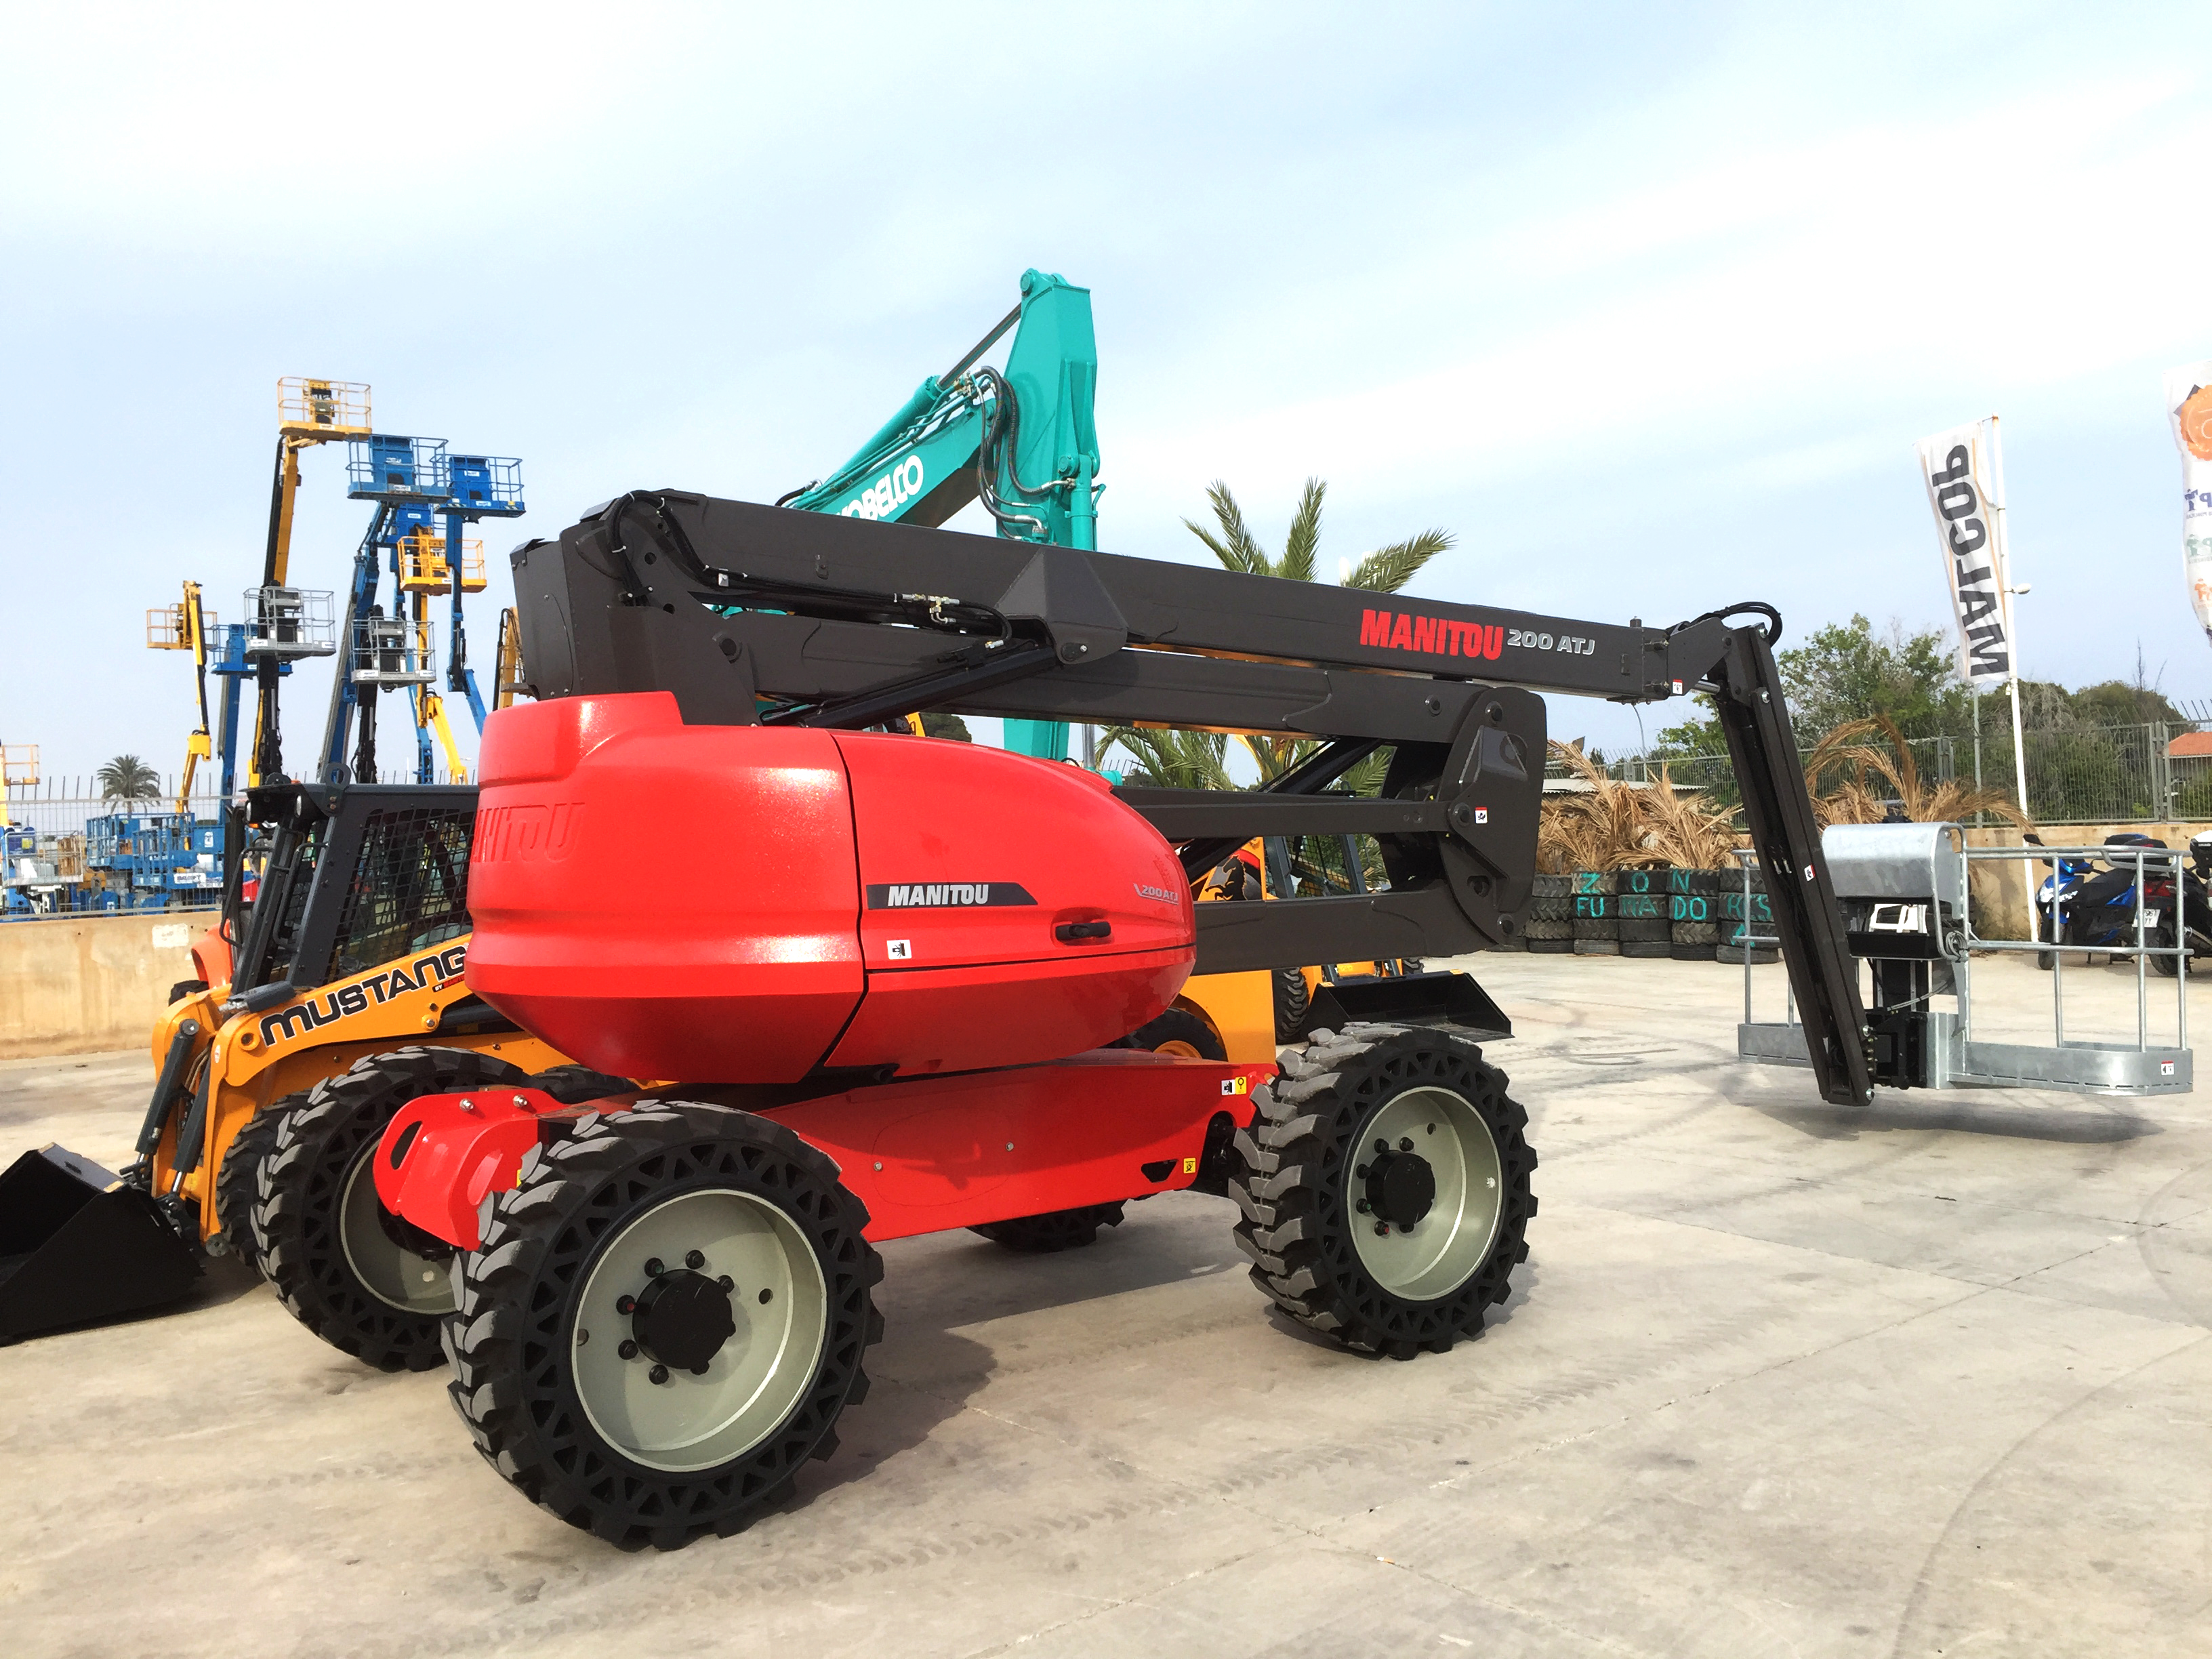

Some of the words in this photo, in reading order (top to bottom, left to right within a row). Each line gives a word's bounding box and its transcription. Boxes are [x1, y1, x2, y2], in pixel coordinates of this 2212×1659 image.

[836, 455, 924, 520] BELCO
[1359, 609, 1504, 661] MANITOU
[1507, 628, 1553, 651] 200
[1557, 635, 1595, 656] ATJ
[470, 802, 586, 863] NITOU
[887, 884, 989, 907] MANITOU
[1141, 884, 1163, 898] 200
[260, 945, 466, 1047] MUSTANG
